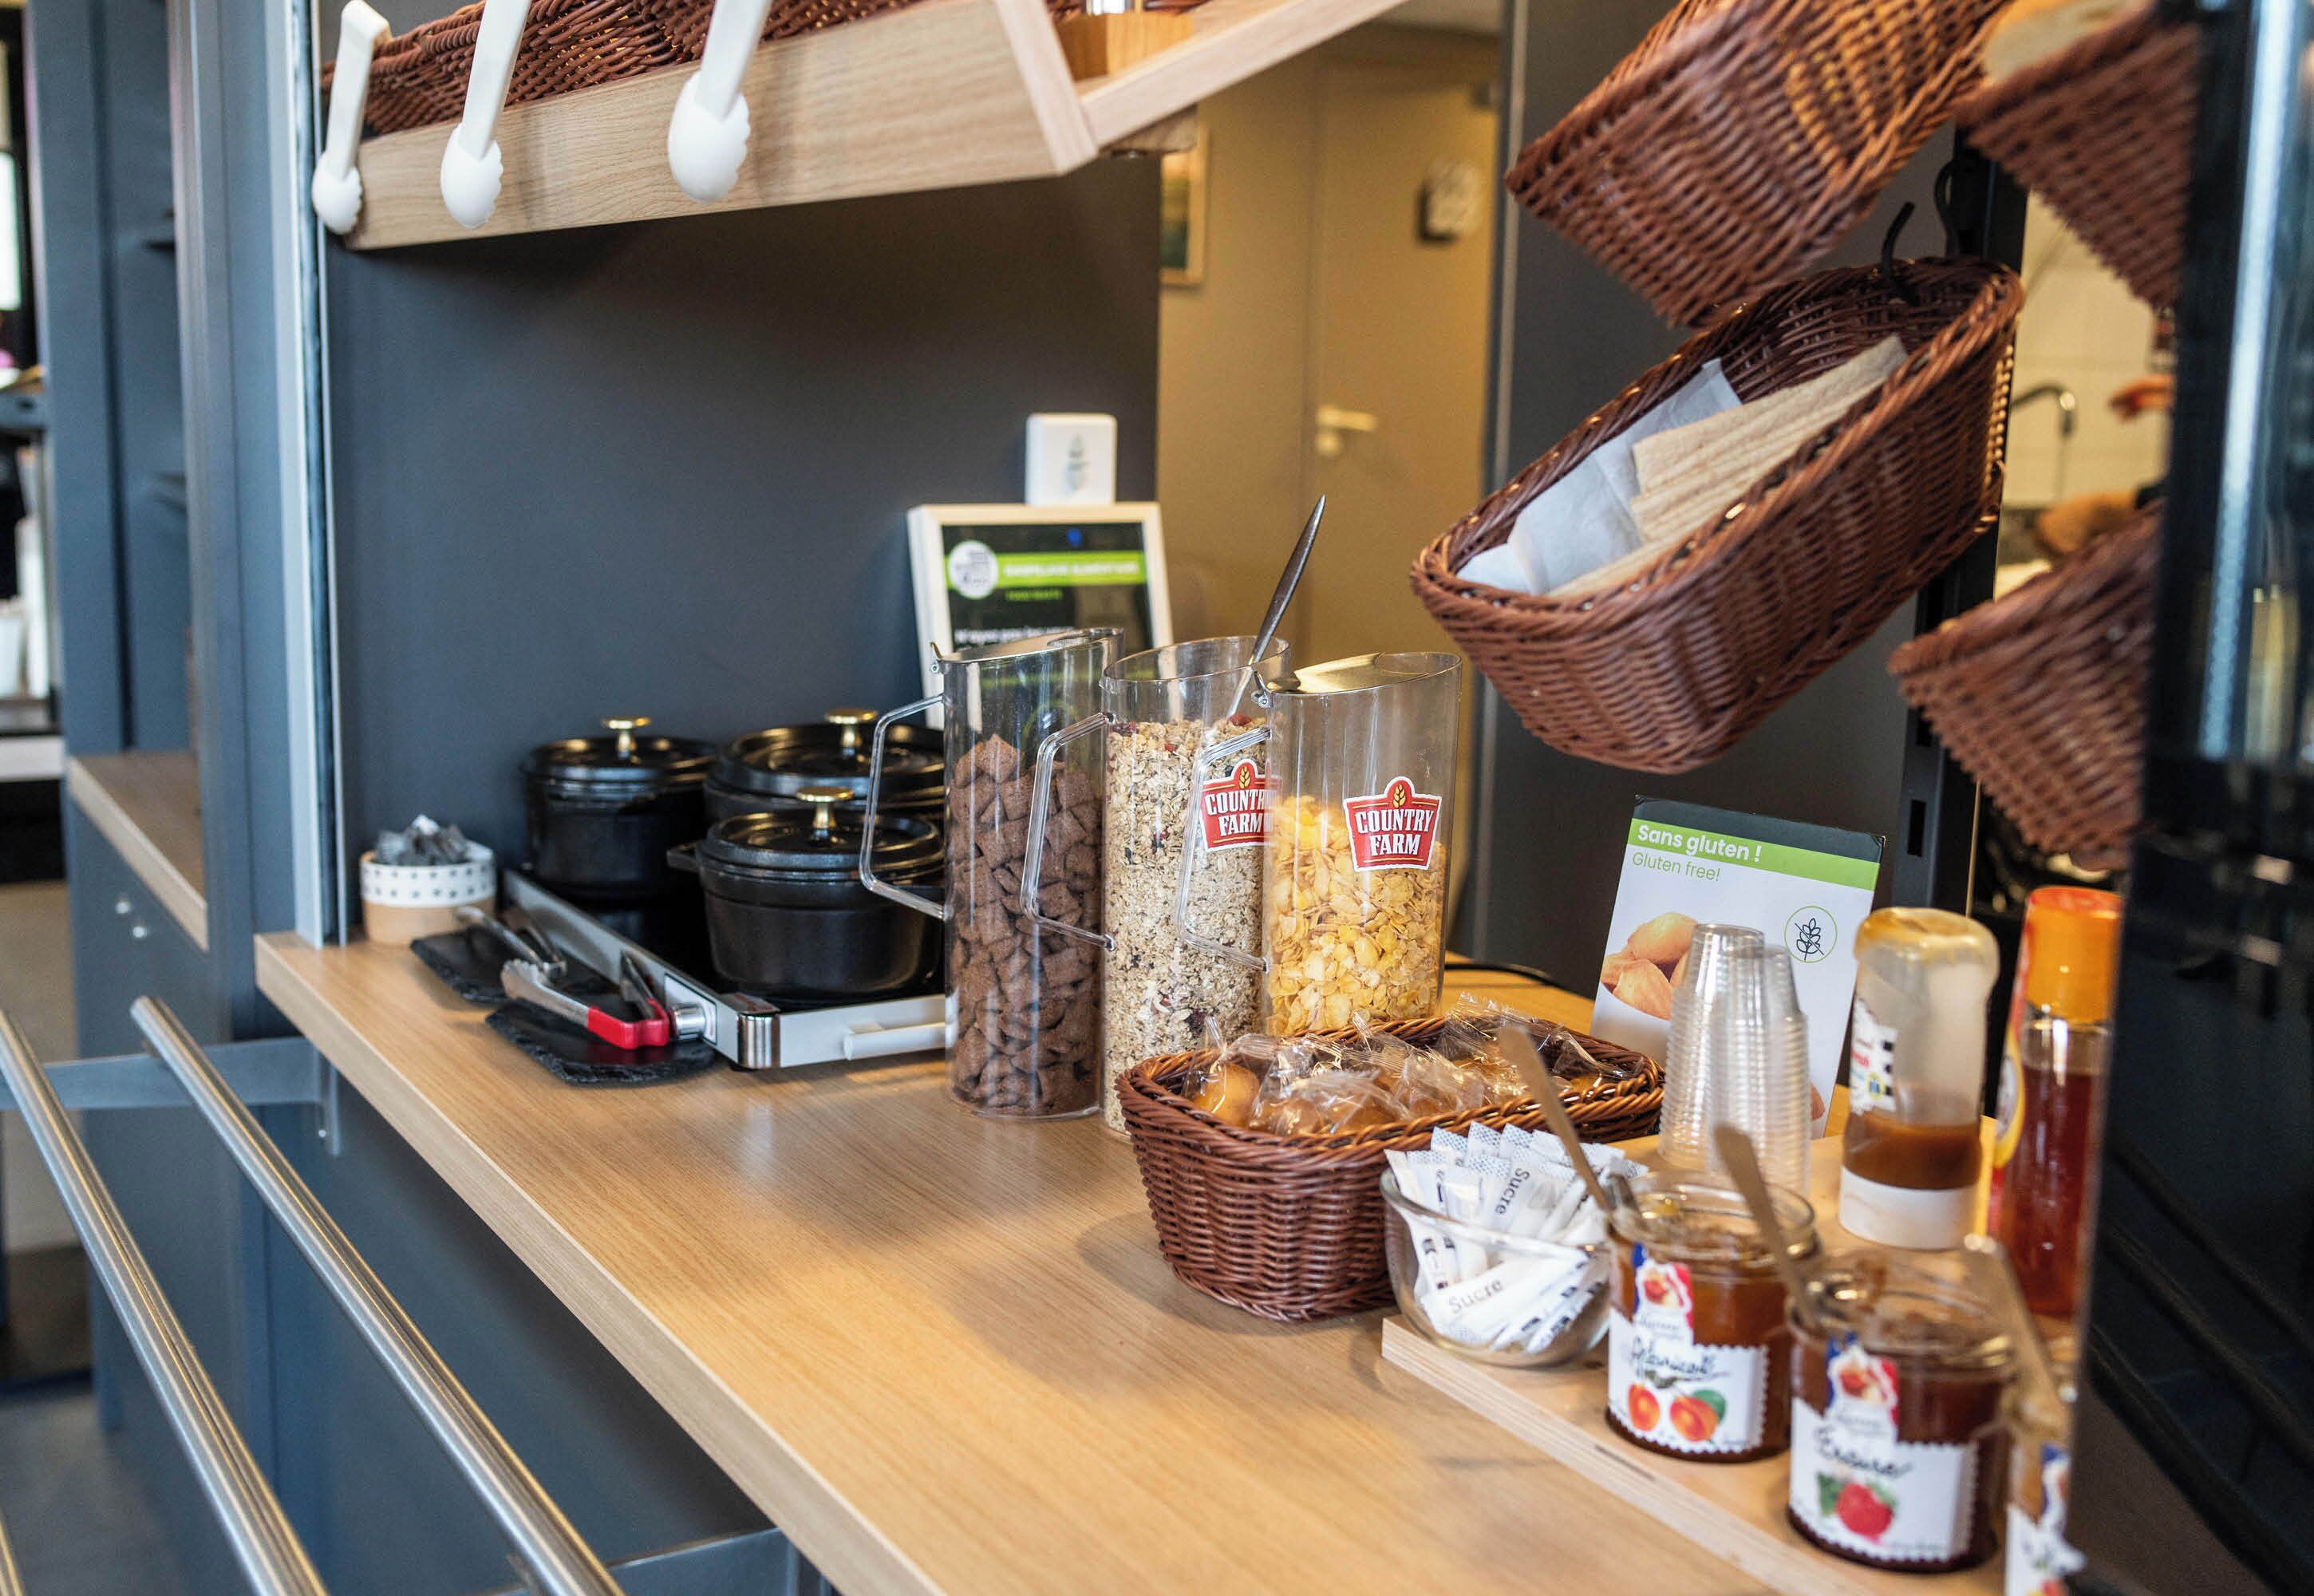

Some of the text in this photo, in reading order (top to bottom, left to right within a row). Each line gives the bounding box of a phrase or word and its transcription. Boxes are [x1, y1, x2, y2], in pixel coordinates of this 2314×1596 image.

[1205, 789, 1266, 816] COUNTR
[1218, 812, 1264, 836] FARM
[1355, 808, 1435, 834] COUNTRY
[1369, 833, 1421, 856] FARM
[1638, 824, 1684, 847] Sans
[1685, 835, 1750, 861] gluten
[1633, 851, 1722, 882] Gluten free!
[1495, 1167, 1530, 1215] Sucre
[1448, 1279, 1503, 1314] Sucre
